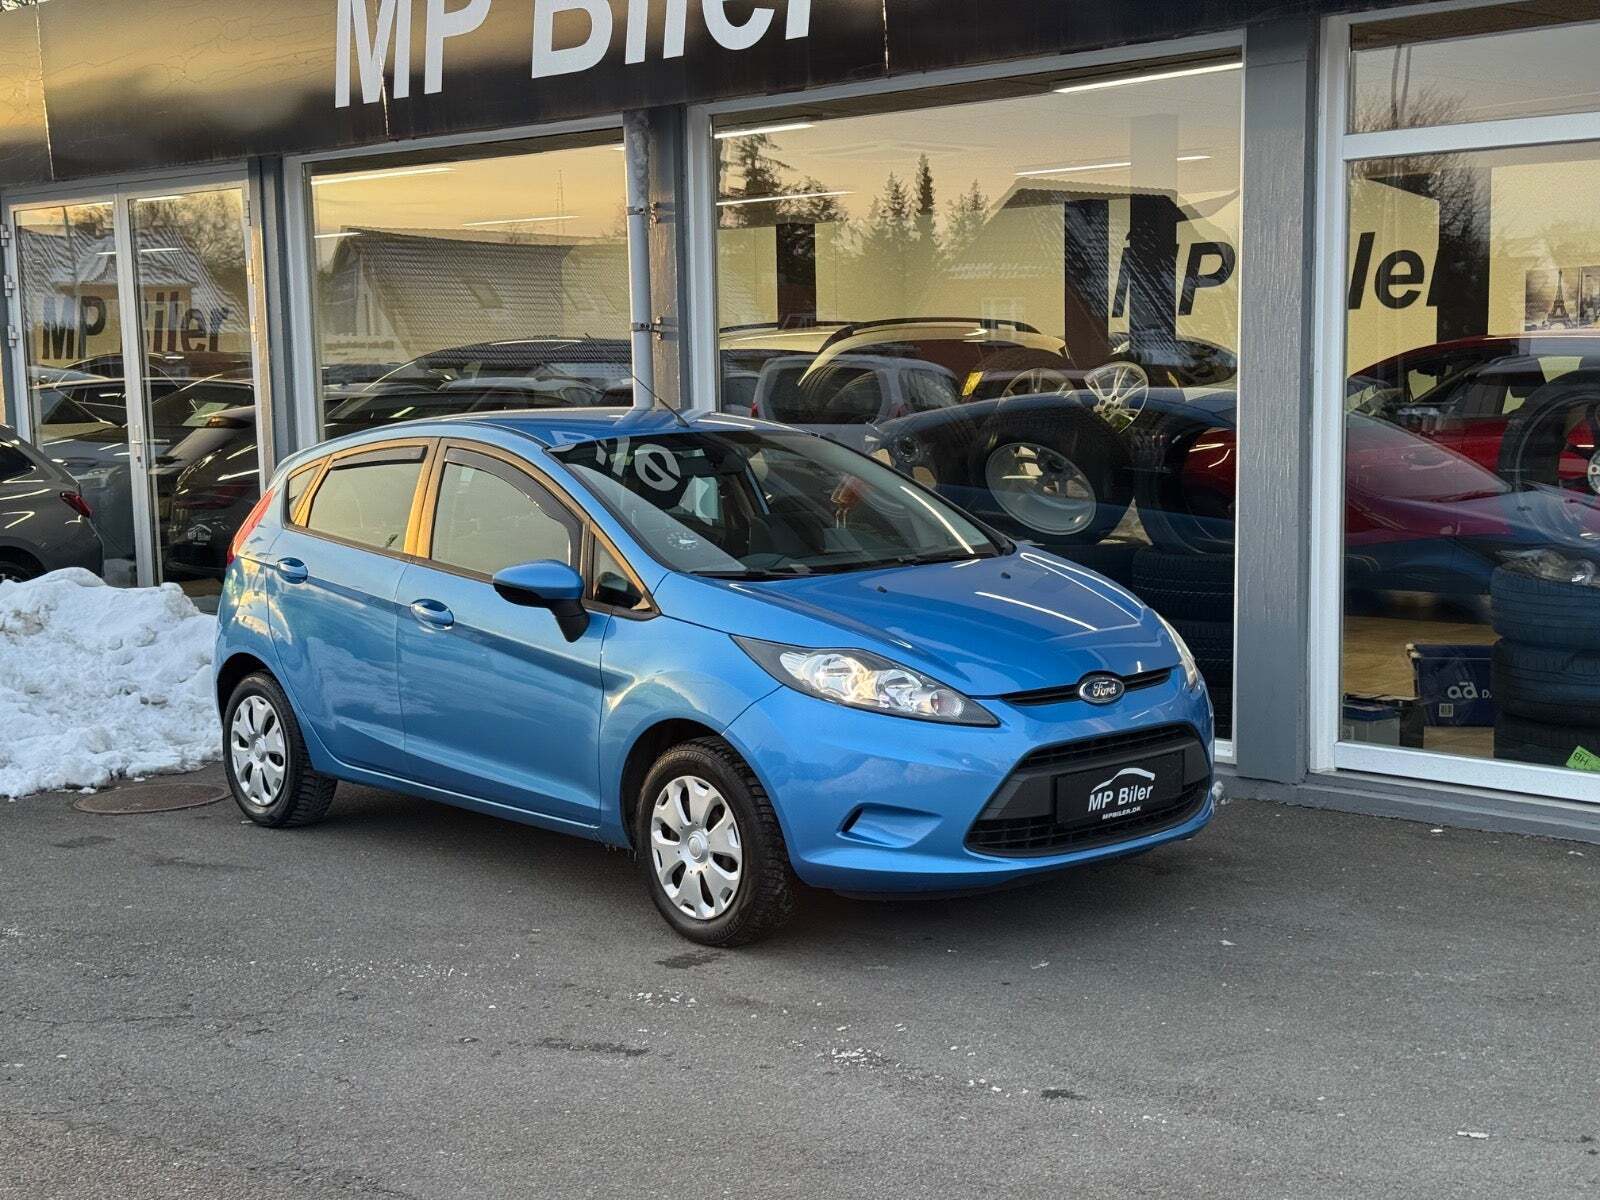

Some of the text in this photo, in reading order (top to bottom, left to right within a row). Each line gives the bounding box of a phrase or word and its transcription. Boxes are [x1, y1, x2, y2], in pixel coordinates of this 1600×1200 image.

[334, 0, 491, 108] MP
[41, 291, 229, 360] MP iler
[1092, 680, 1118, 698] Ford
[1087, 784, 1154, 812] MP Biler
